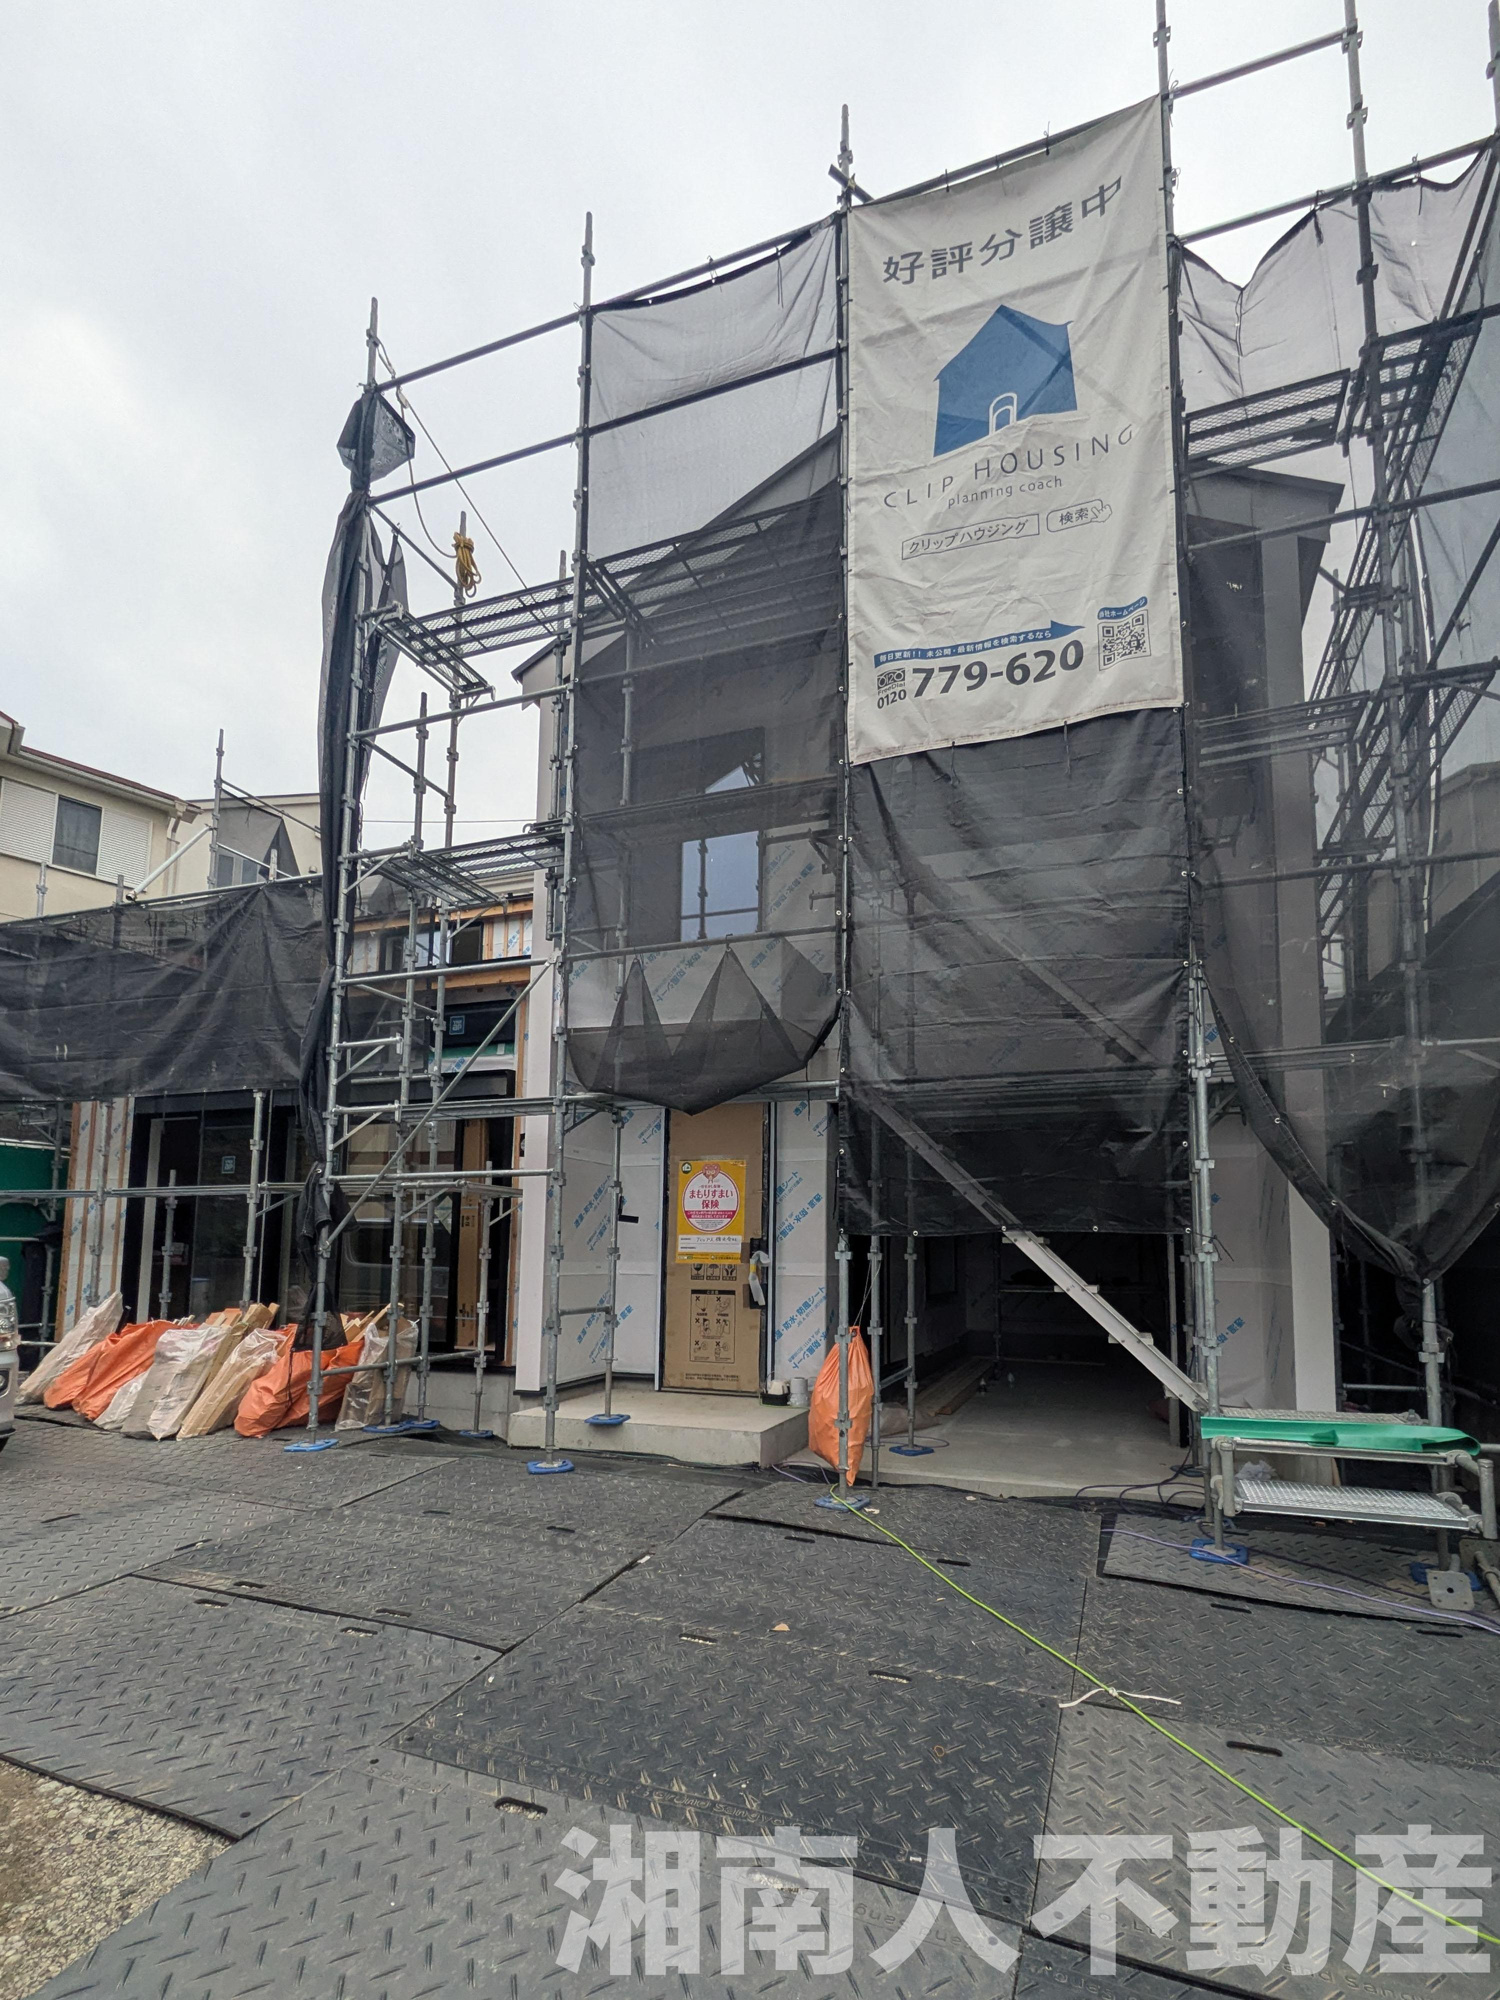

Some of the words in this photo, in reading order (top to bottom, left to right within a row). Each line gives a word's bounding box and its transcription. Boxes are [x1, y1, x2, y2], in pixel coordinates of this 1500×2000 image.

[883, 176, 1122, 285] 好評分譲中
[883, 475, 954, 508] CLIP
[974, 424, 1133, 480] HOUSING
[947, 483, 1013, 509] planning
[1019, 475, 1063, 493] coach
[908, 518, 1029, 554] クリップハウジング
[1058, 506, 1089, 526] 検索
[877, 688, 907, 709] 0120
[912, 640, 1084, 698] 779-620
[689, 1188, 734, 1199] まもりすまい
[701, 1199, 720, 1210] 保険
